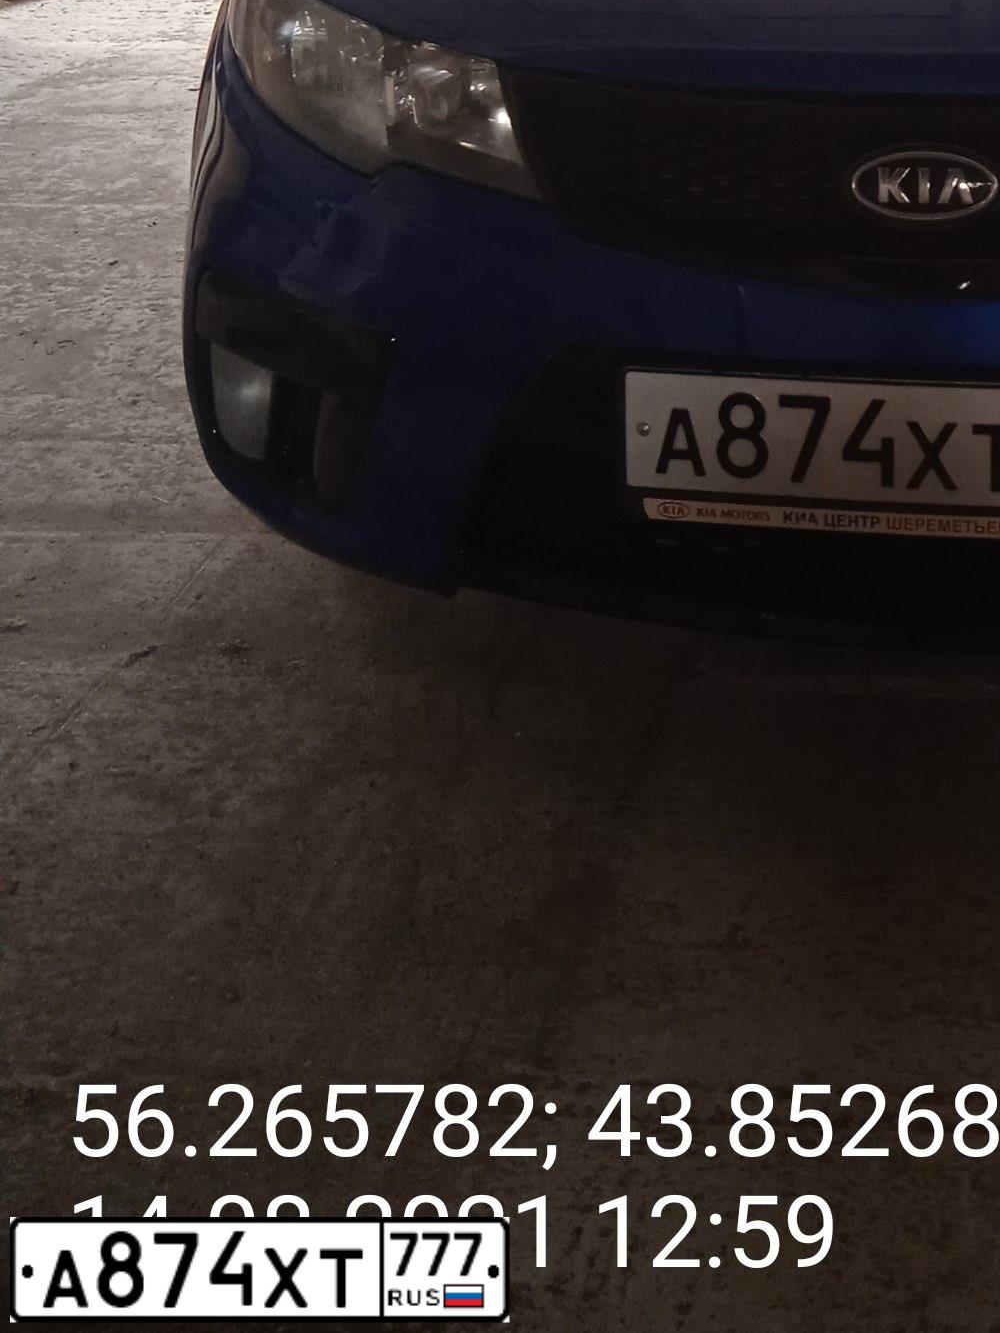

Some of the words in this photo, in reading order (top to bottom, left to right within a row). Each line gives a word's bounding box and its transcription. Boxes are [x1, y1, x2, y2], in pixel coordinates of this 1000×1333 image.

[876, 167, 974, 205] KIA
[697, 507, 717, 518] KIA
[720, 508, 771, 521] MOTORS
[783, 511, 818, 527] КИА
[824, 514, 881, 530] ЦЕНТР
